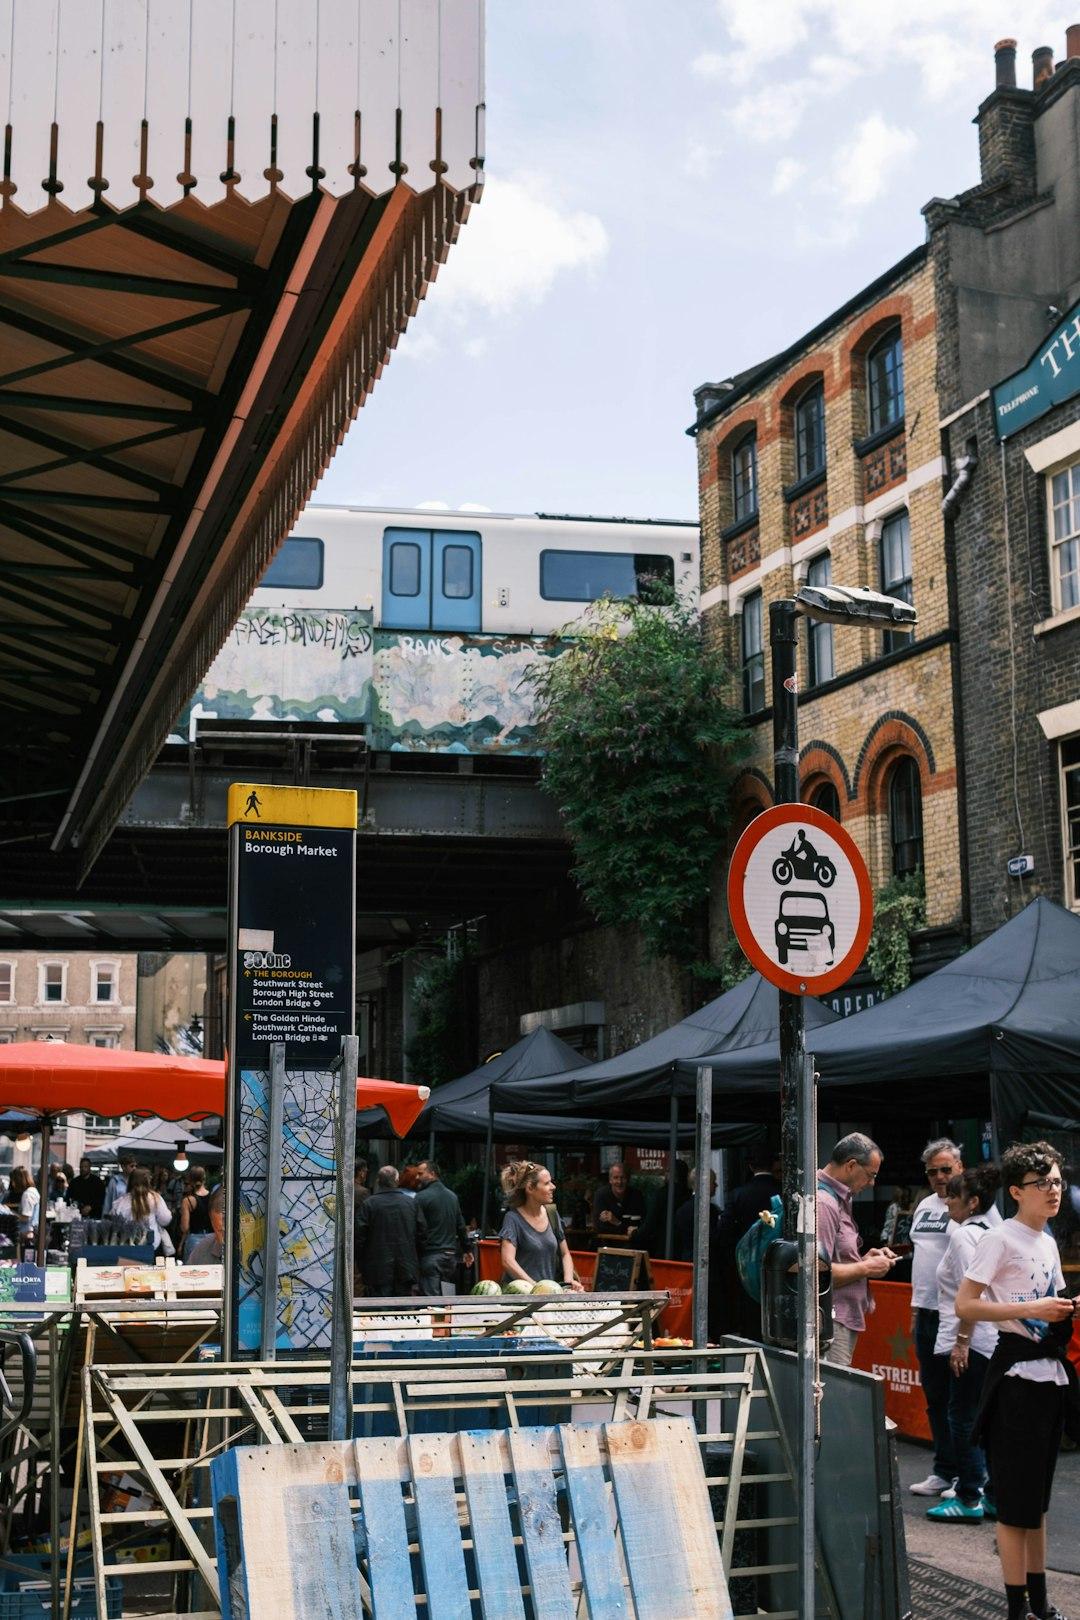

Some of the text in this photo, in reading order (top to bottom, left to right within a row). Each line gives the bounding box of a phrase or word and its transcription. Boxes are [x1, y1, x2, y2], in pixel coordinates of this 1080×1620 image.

[998, 385, 1039, 416] TELEPHONE
[244, 829, 303, 842] BANKSIDE
[244, 842, 338, 857] Borough Market
[253, 970, 313, 979] THE BOROUGH
[252, 979, 323, 989] Southwark Street
[252, 989, 334, 999] Borough High Street
[252, 998, 311, 1009] London Bridge
[252, 1013, 326, 1023] The Golden Hinde
[252, 1023, 338, 1033] Southwark Cathedral
[252, 1033, 311, 1043] London Bridge
[915, 1220, 947, 1231] grimsby
[871, 1363, 922, 1387] ESTRELL
